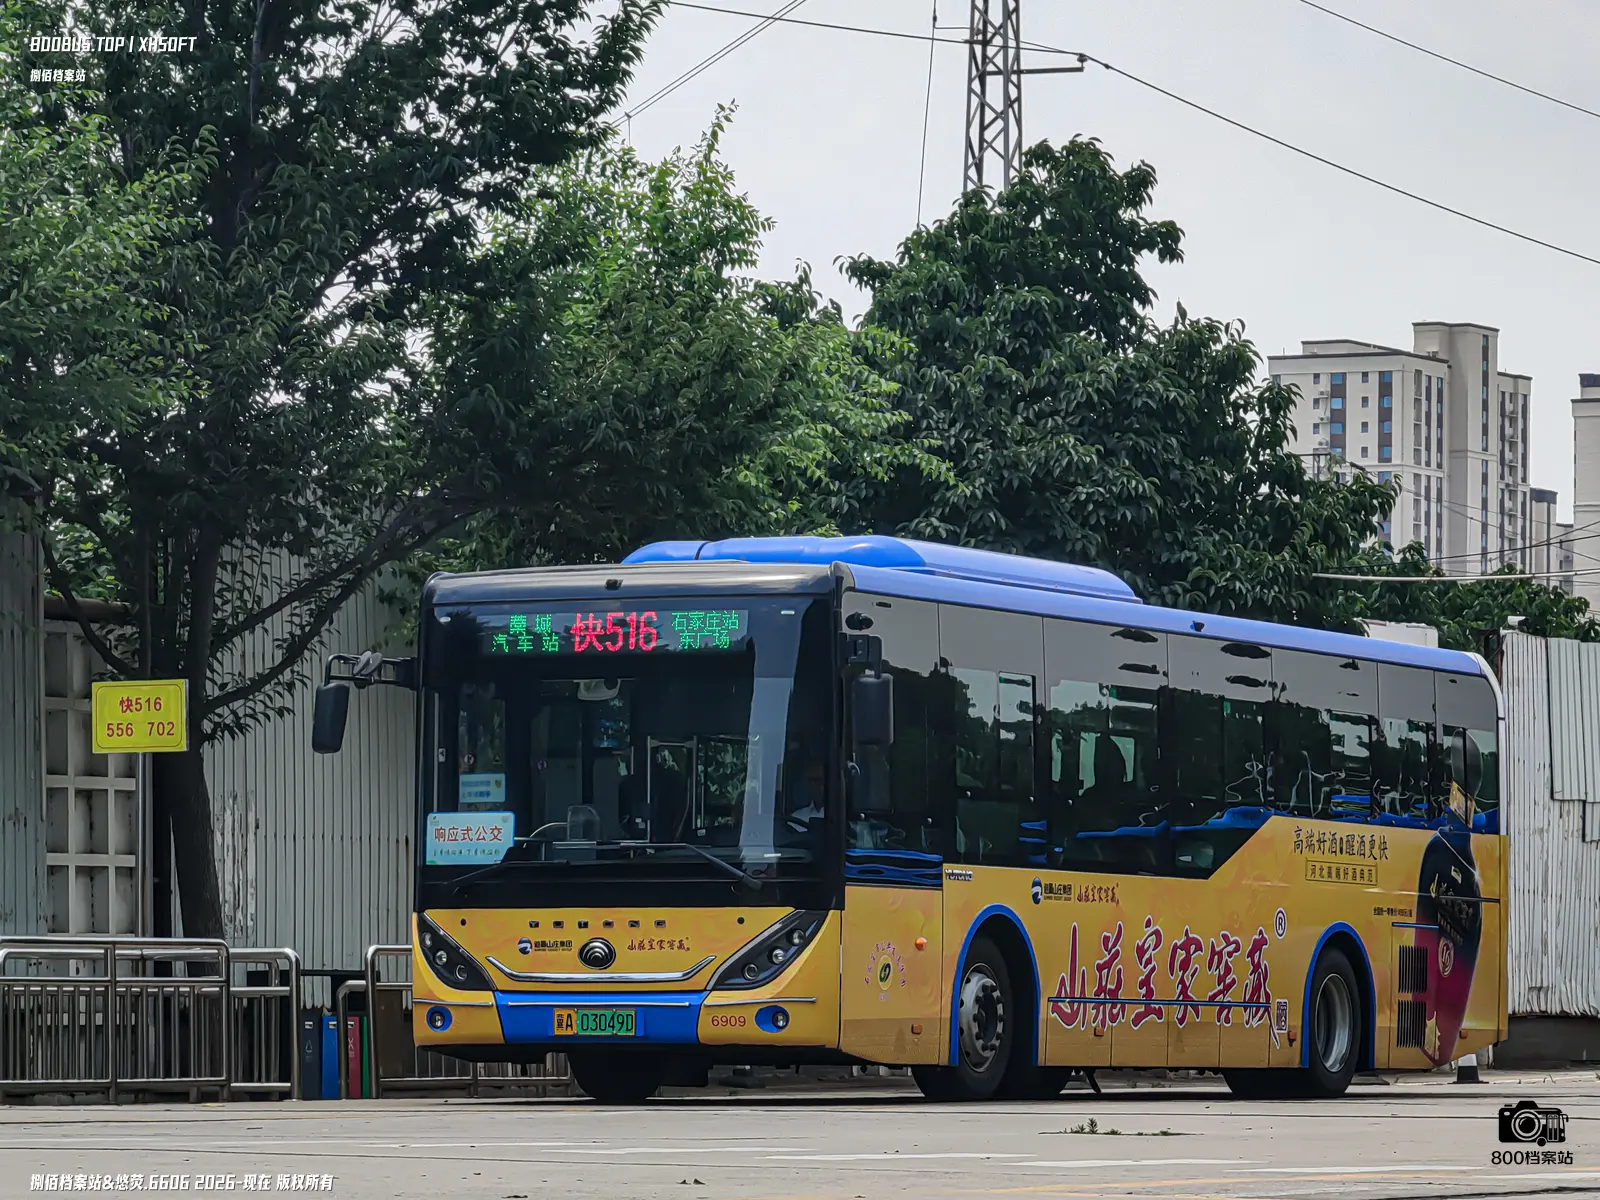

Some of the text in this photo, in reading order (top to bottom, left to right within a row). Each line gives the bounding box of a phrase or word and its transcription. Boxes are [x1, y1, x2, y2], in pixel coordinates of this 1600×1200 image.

[672, 610, 738, 631] 石家庄站
[570, 612, 657, 652] 快516
[679, 629, 730, 649] 东广场
[492, 632, 559, 652] 汽车站
[119, 696, 162, 713] 快516
[106, 721, 175, 737] 556 702
[434, 825, 503, 842] 响应式公交
[711, 1015, 747, 1027] 6909
